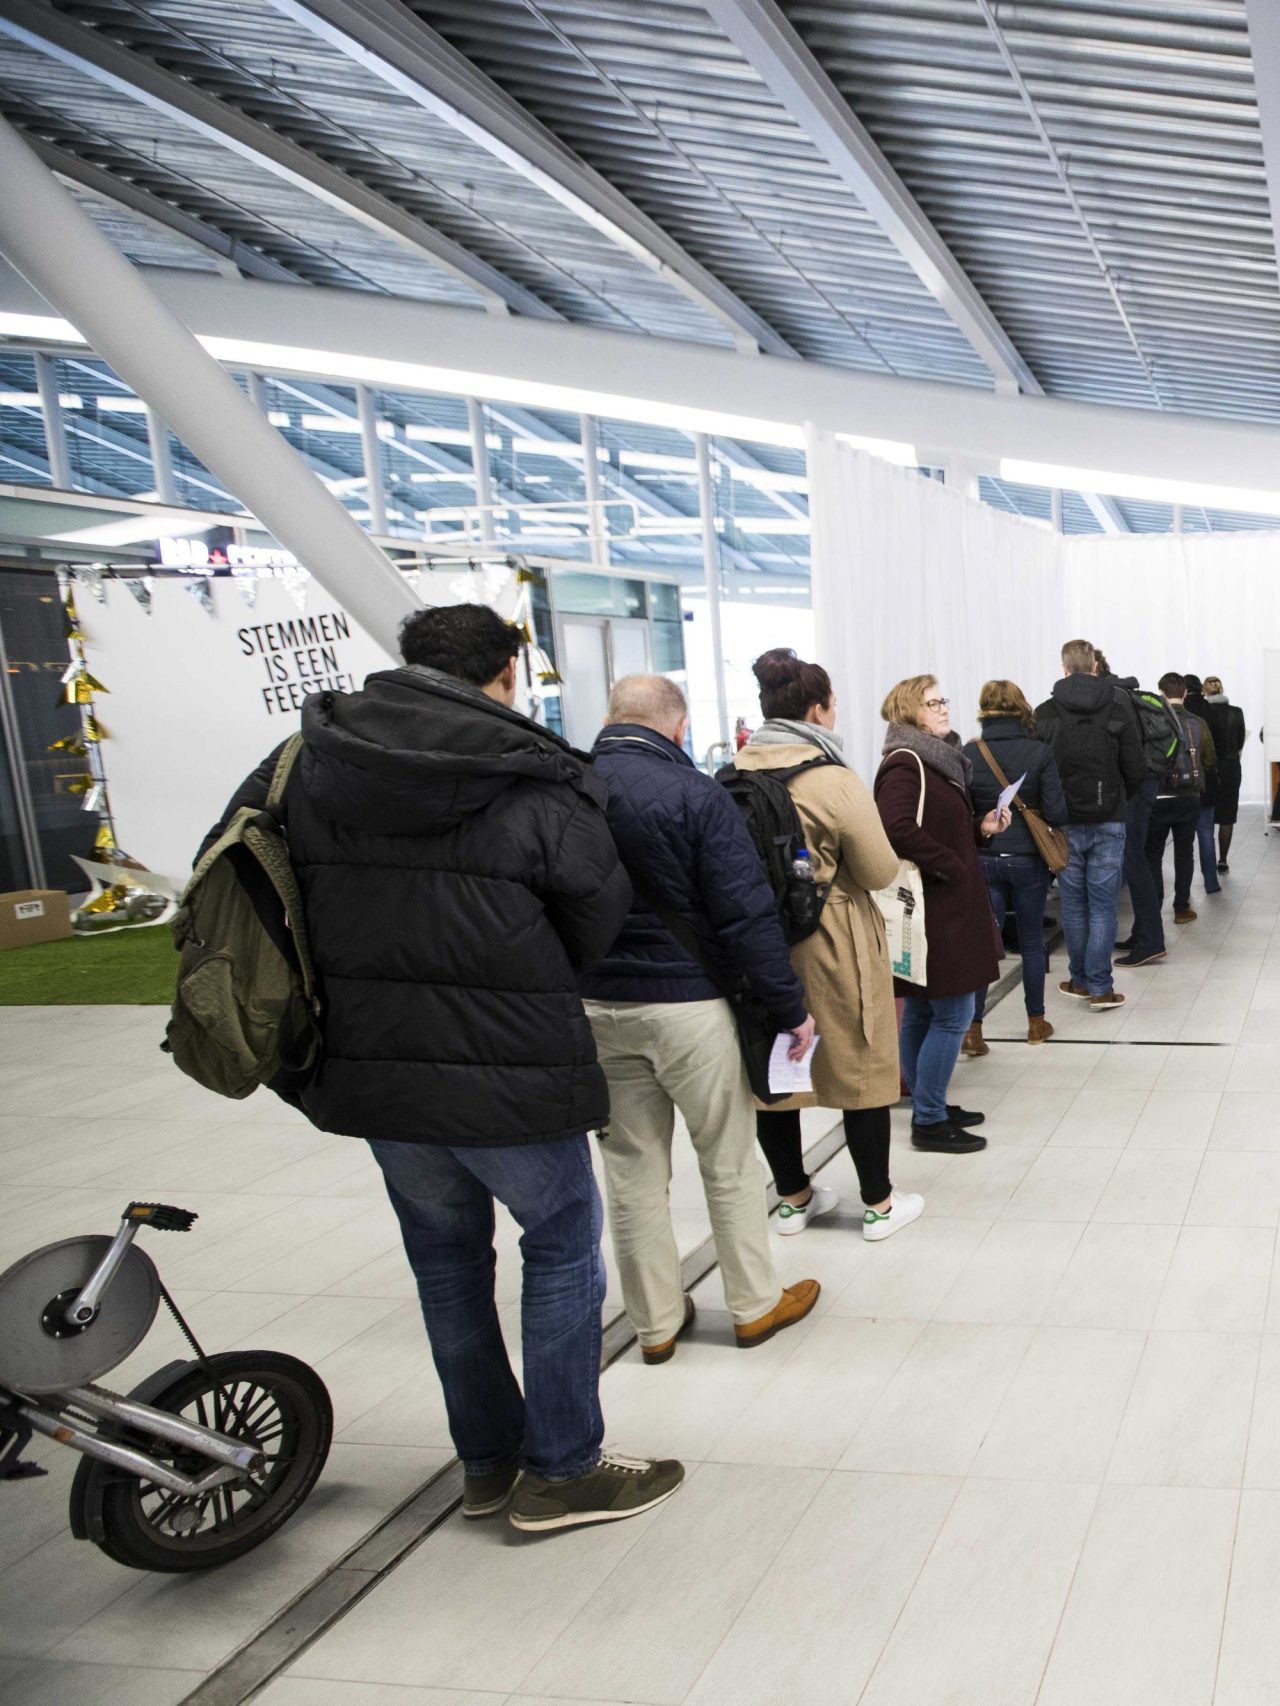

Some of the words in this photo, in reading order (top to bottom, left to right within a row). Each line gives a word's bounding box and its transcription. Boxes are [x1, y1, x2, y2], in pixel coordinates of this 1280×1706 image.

[238, 612, 351, 656] STEMMEN
[264, 655, 289, 683] IS
[294, 646, 339, 678] EEN
